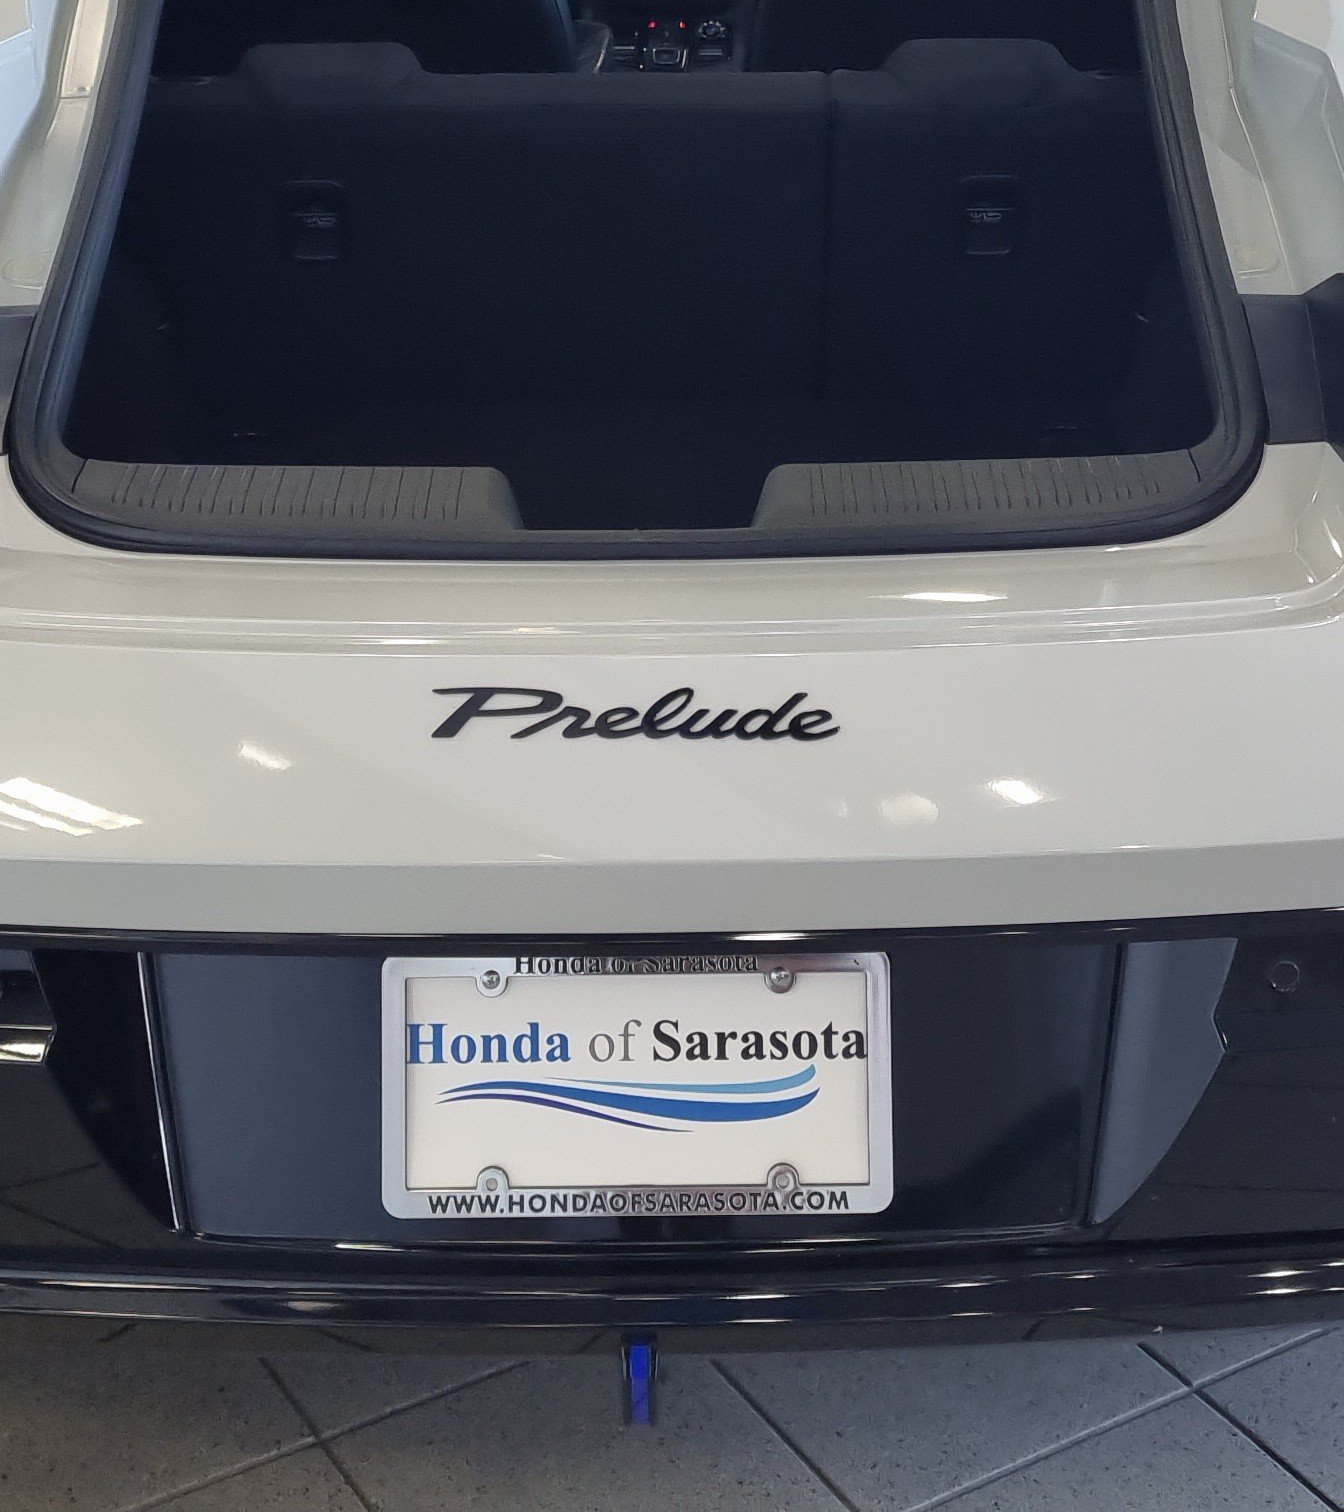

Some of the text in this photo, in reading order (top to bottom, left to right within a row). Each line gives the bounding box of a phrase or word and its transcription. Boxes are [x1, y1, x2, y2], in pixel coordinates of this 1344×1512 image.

[431, 687, 840, 741] Prelude
[514, 956, 602, 974] Honda
[406, 1019, 867, 1065] Honda of Sarasota
[428, 1190, 850, 1214] WWW.HONDAOFSARASOTA.COM
